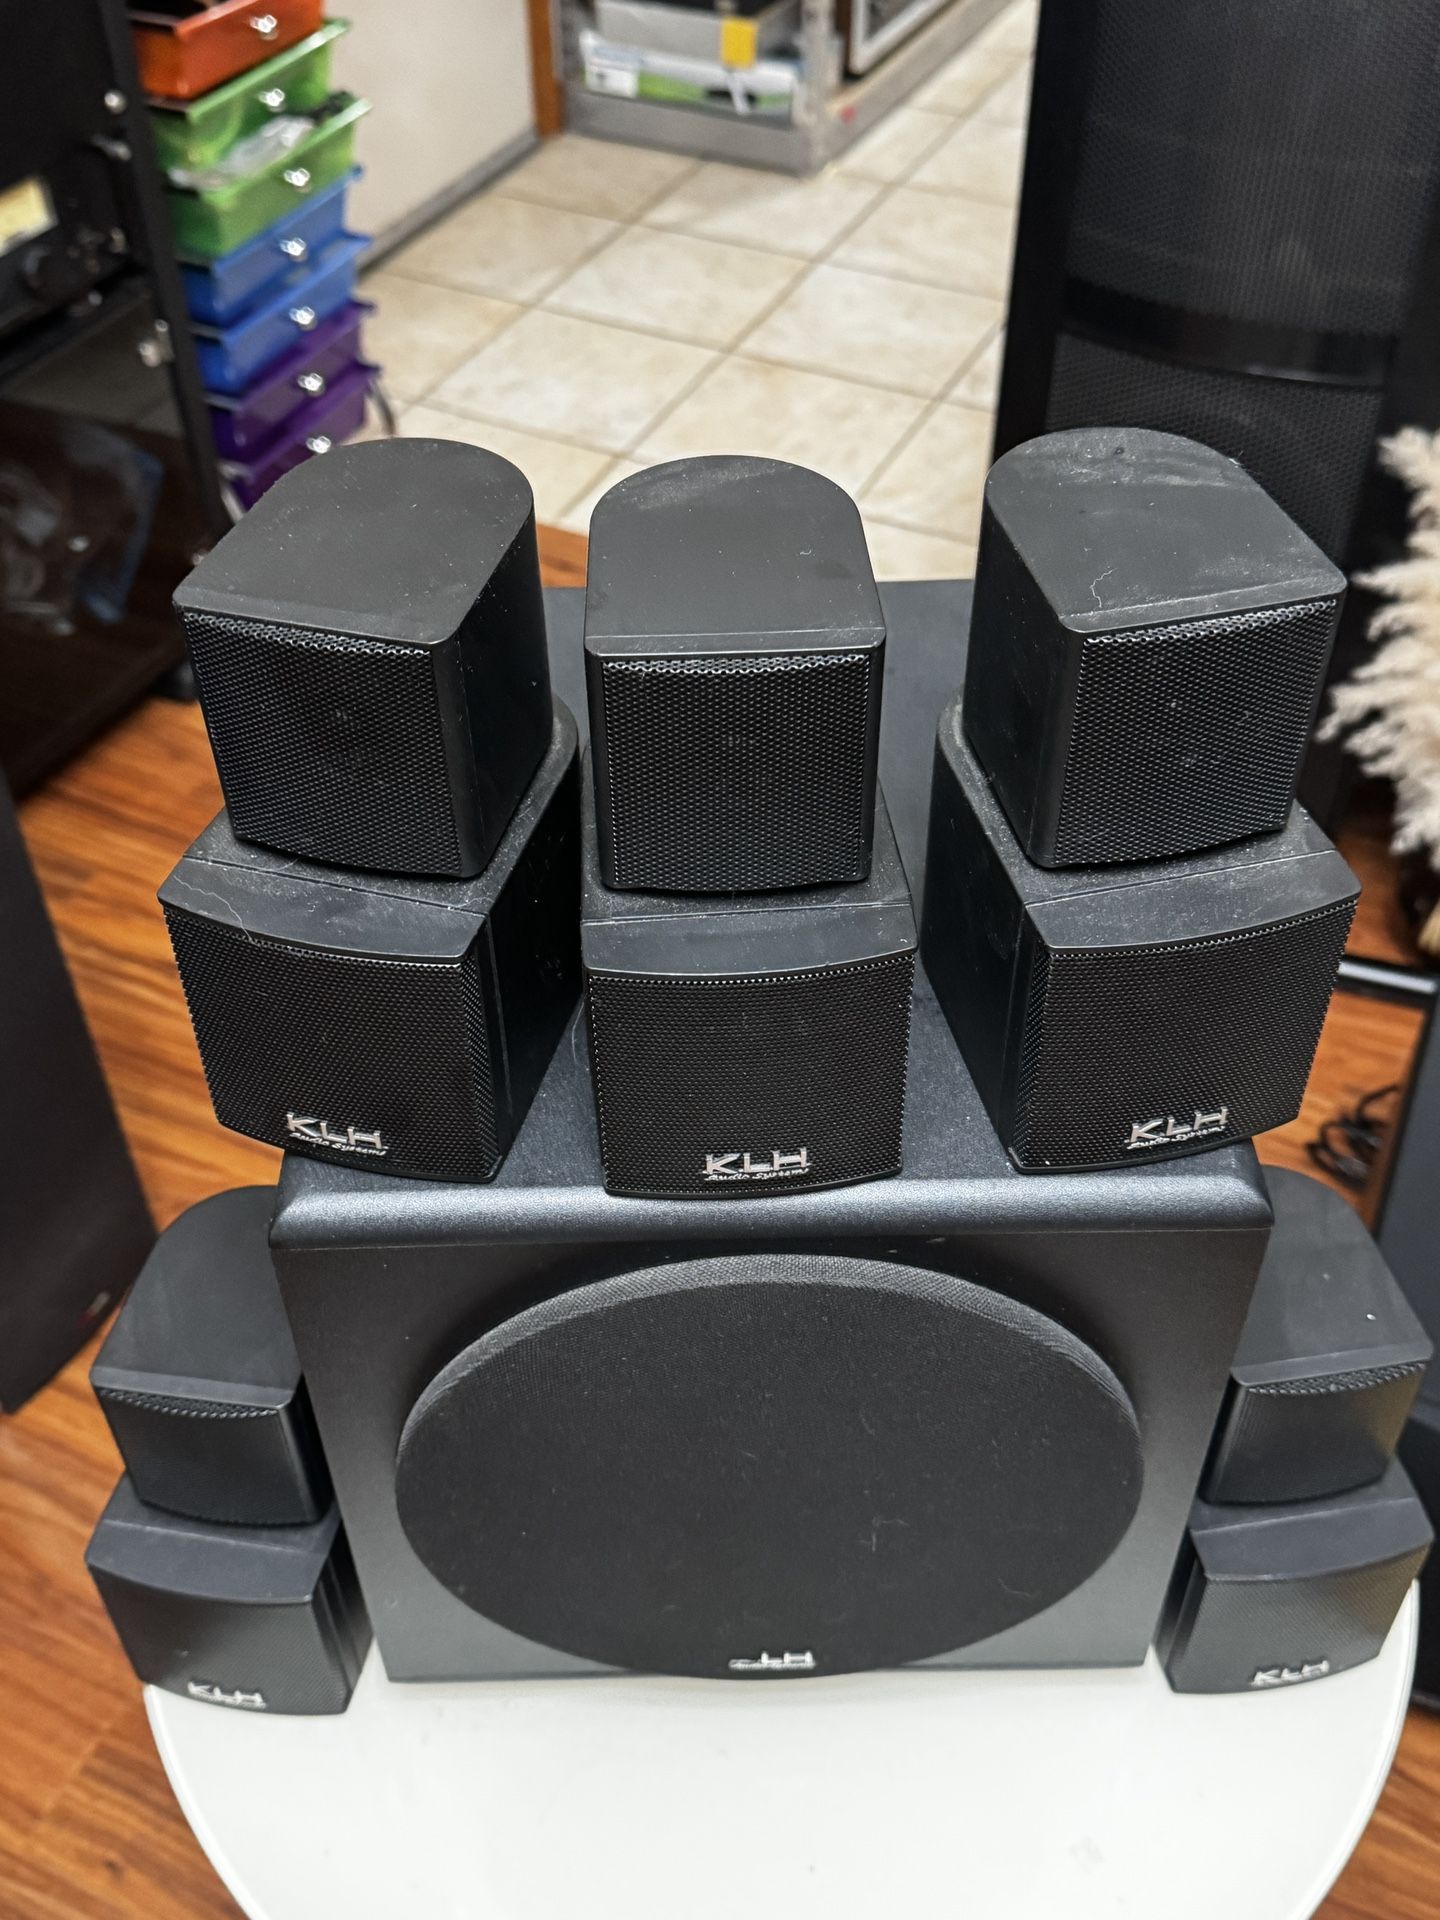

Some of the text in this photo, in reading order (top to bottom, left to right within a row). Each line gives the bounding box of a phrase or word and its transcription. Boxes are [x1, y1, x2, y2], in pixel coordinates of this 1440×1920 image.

[286, 1111, 382, 1149] KLH
[1130, 1106, 1228, 1142] KLH
[705, 1147, 807, 1174] KLH
[1253, 1660, 1330, 1685] KLH
[187, 1681, 263, 1704] KLH
